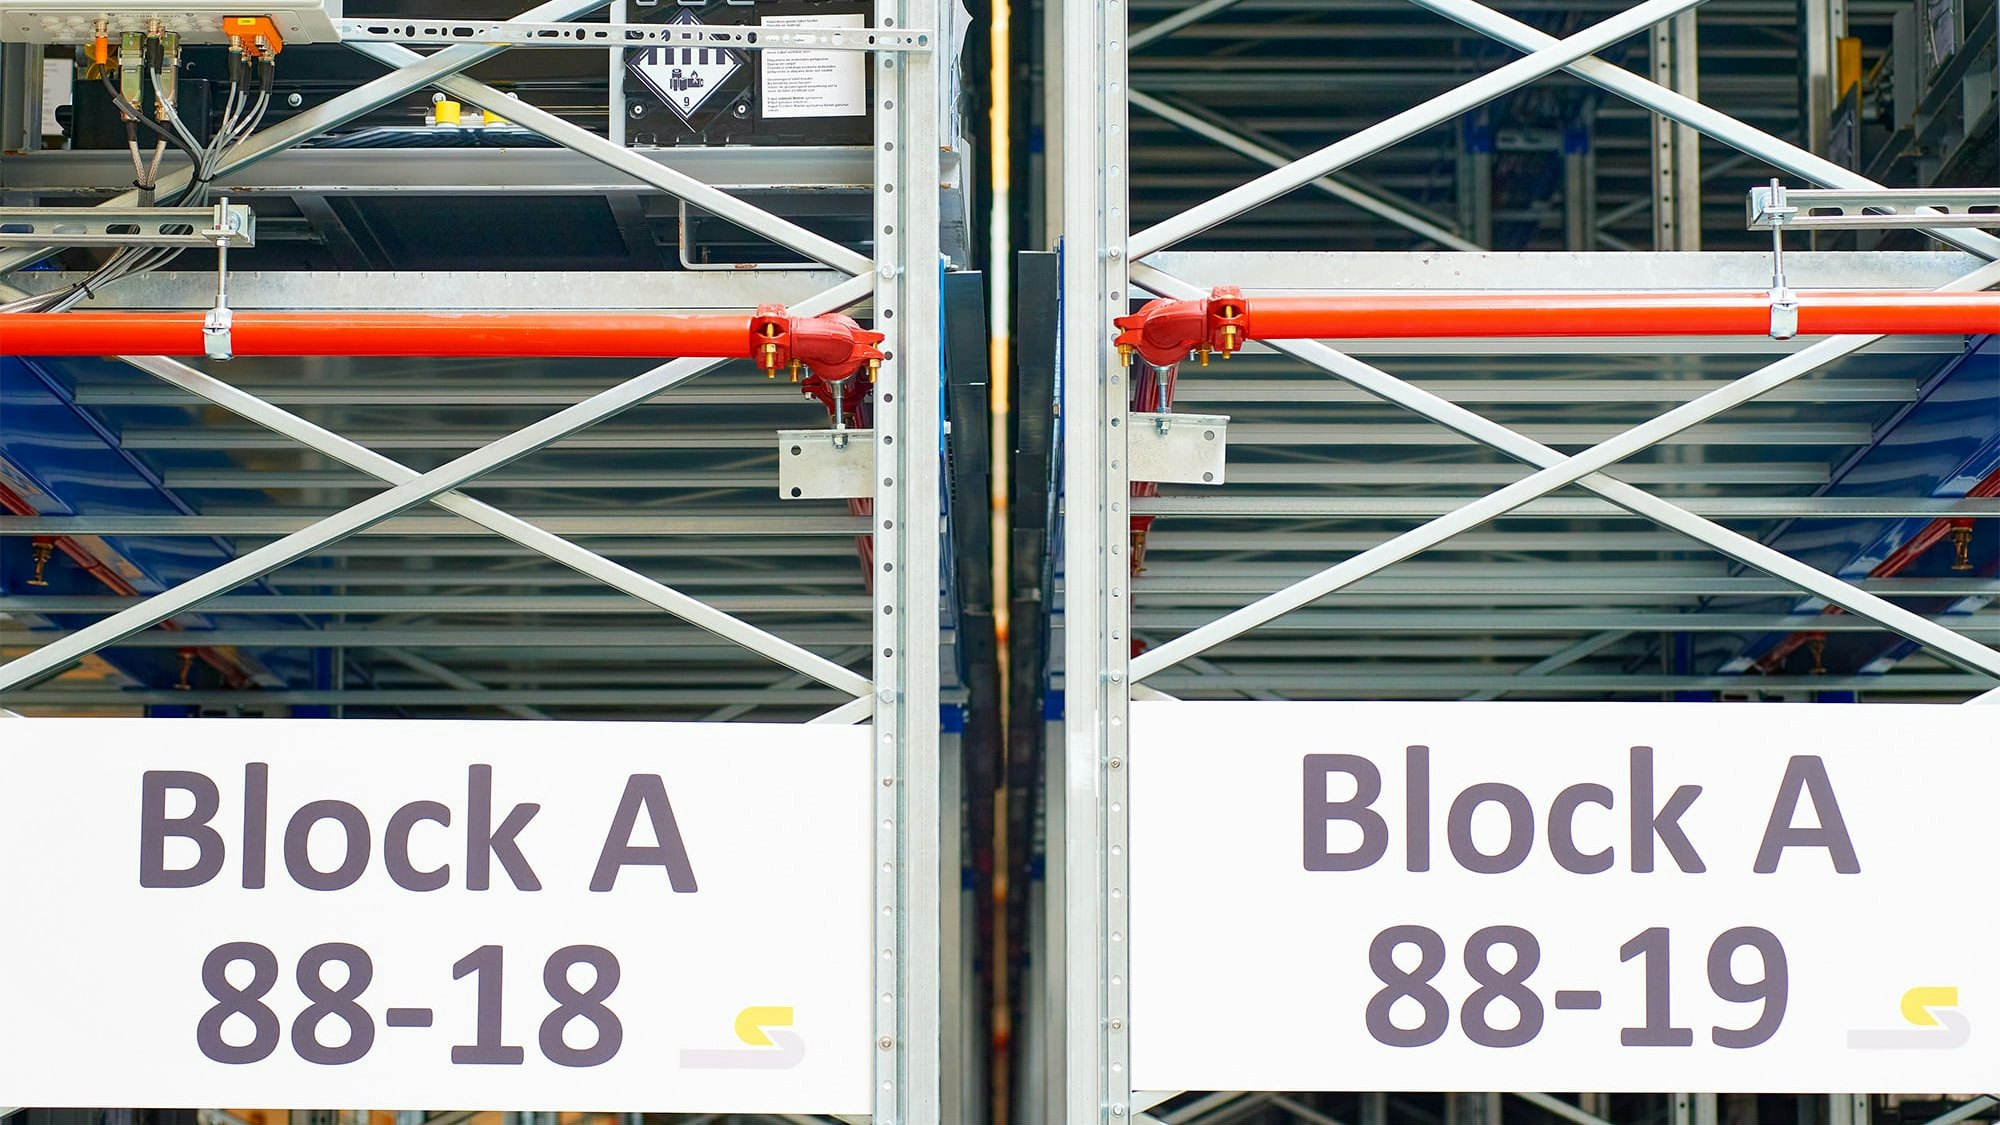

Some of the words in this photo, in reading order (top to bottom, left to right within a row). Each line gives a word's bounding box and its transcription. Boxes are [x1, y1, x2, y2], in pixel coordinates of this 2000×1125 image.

[683, 96, 690, 107] 9
[139, 761, 543, 893] Block
[588, 773, 699, 894] A
[1302, 745, 1707, 875] Block
[1752, 754, 1862, 875] A
[196, 941, 623, 1068] 88-18
[1365, 924, 1790, 1050] 88-19
